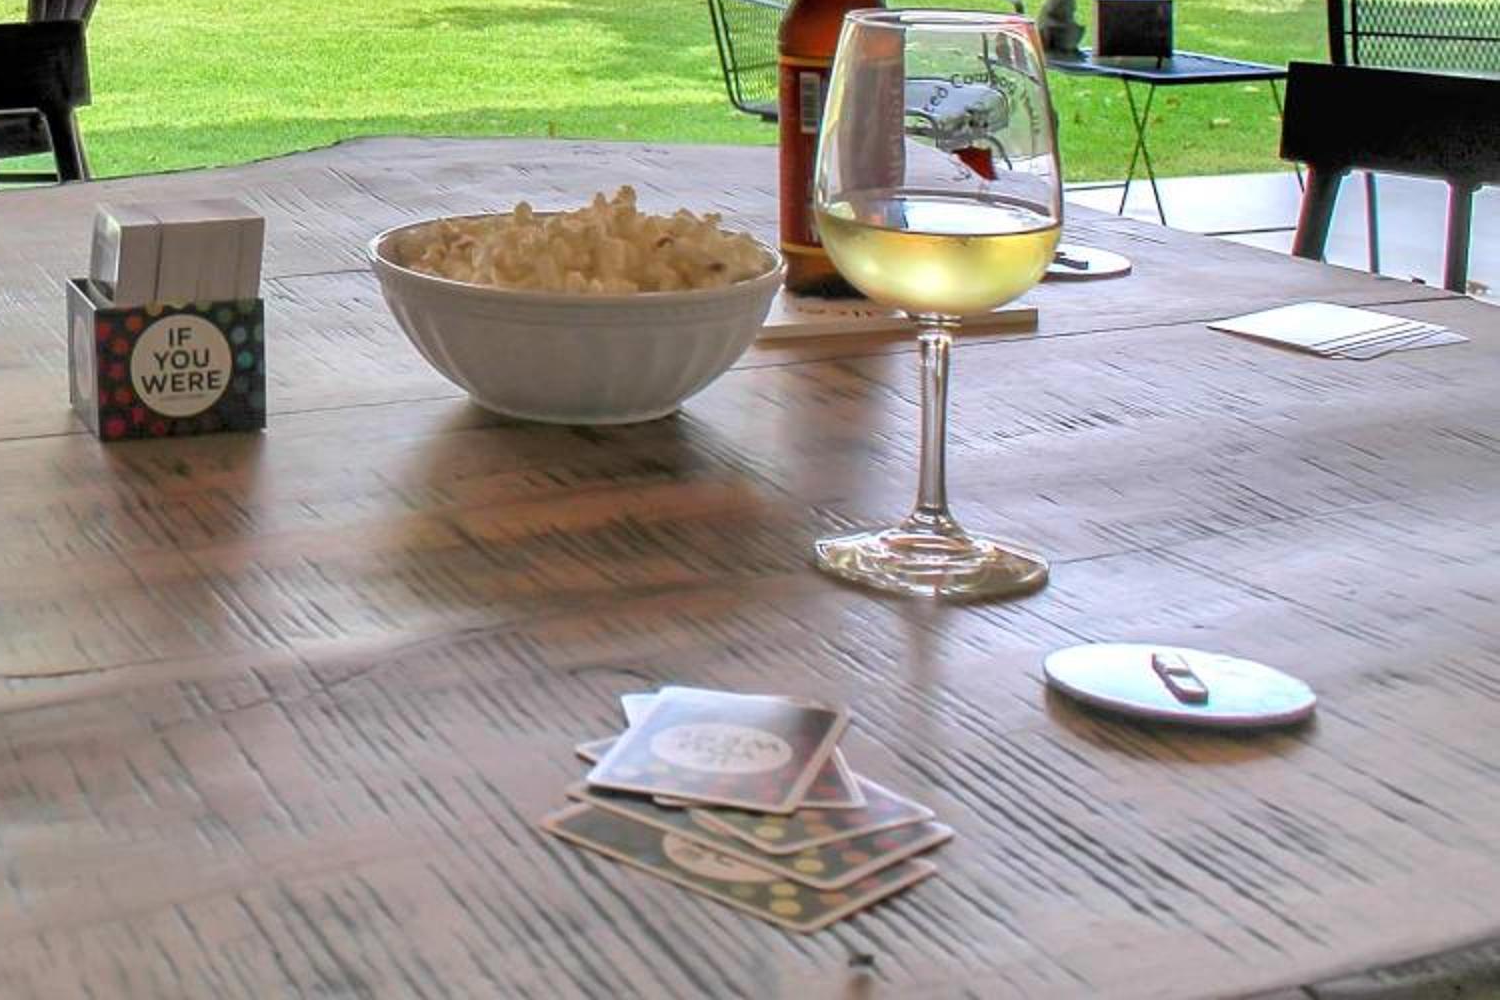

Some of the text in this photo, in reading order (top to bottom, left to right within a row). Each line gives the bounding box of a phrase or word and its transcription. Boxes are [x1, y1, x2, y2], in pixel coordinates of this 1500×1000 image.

[168, 327, 192, 348] IF
[153, 347, 209, 371] YOU
[140, 369, 222, 395] WERE
